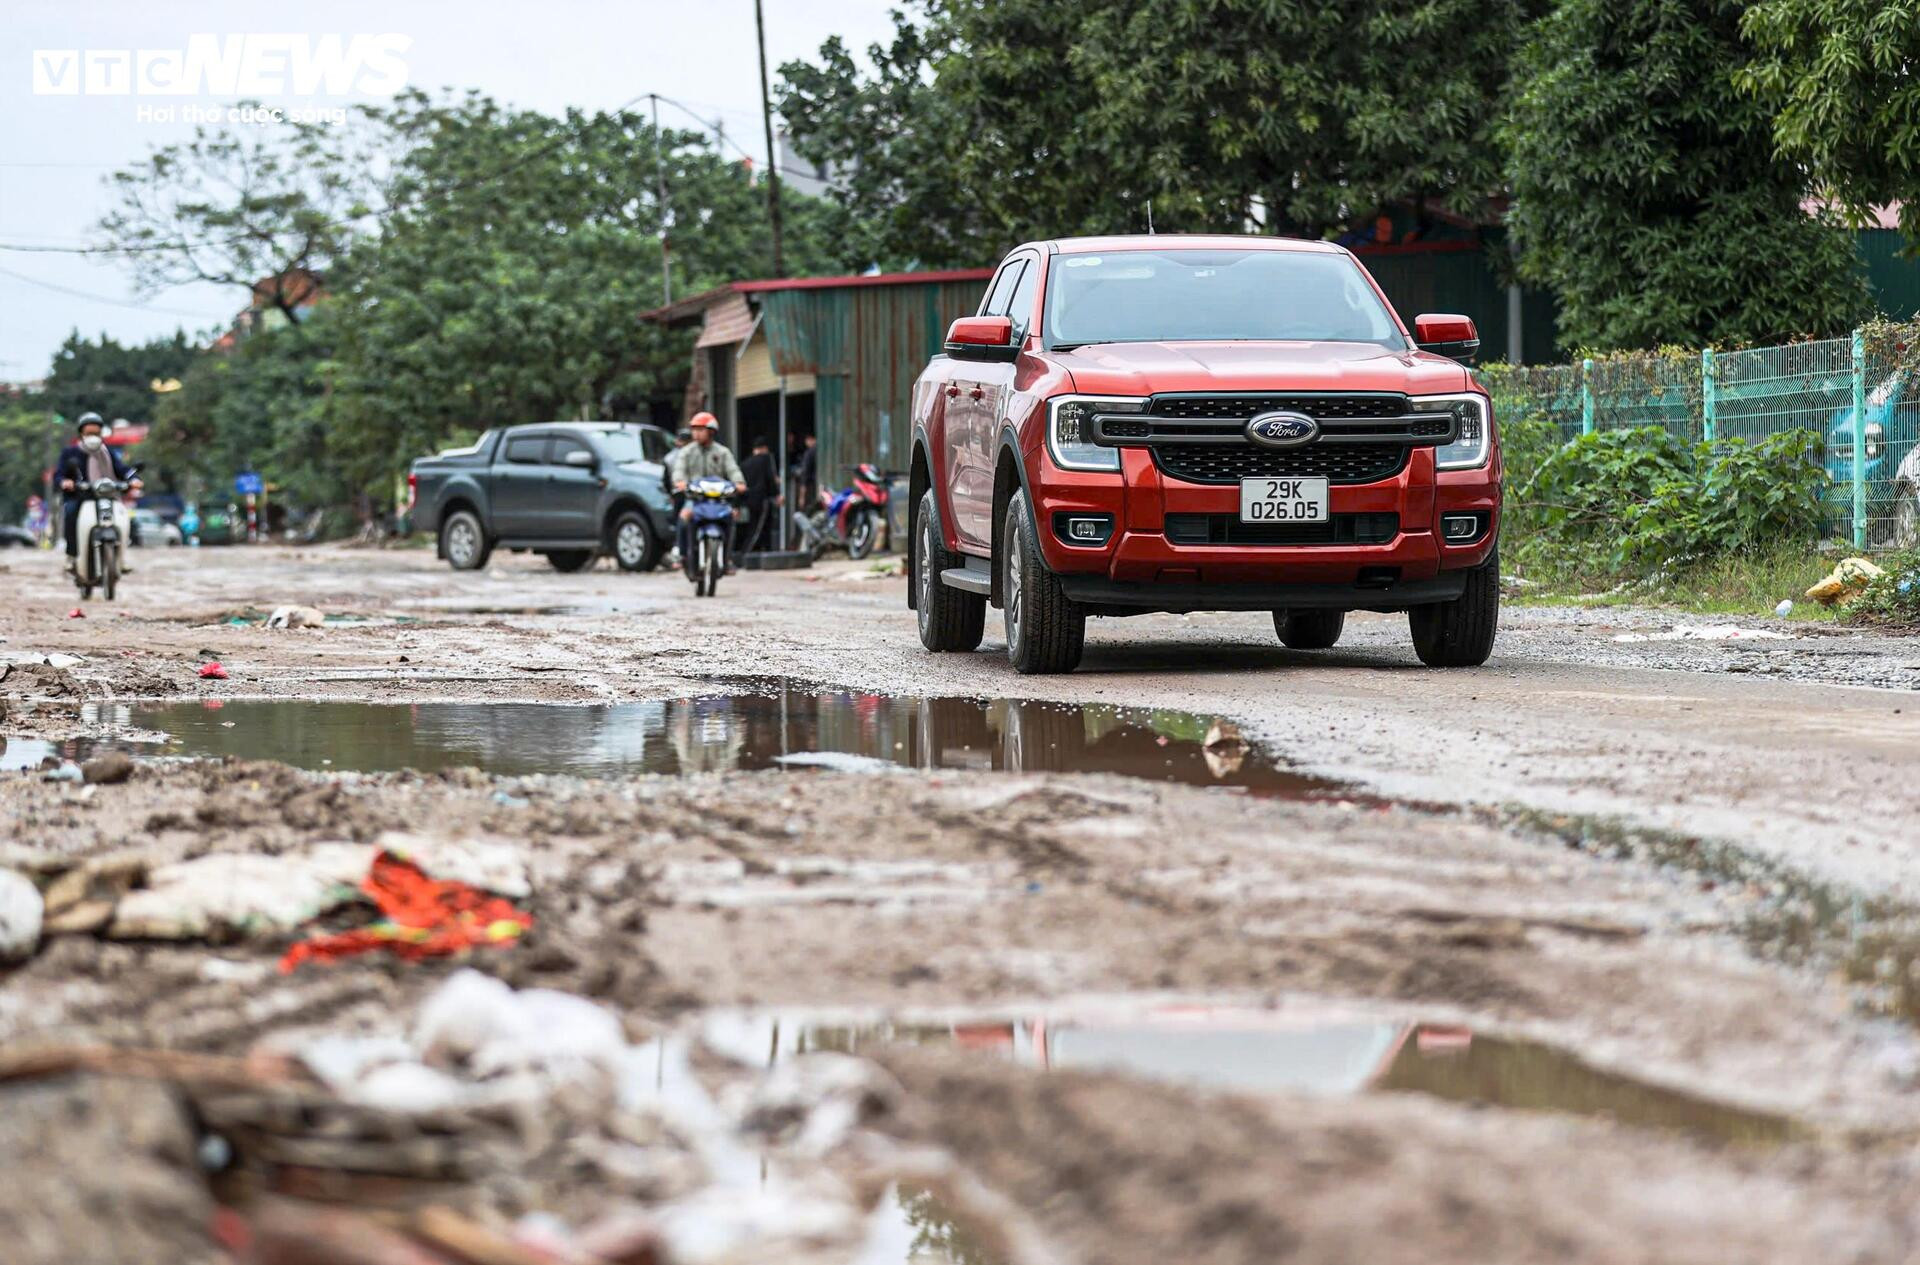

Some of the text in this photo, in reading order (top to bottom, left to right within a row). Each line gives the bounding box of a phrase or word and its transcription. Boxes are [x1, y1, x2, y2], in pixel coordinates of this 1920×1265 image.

[1266, 421, 1300, 436] Ford
[1266, 481, 1302, 499] 29K
[1251, 501, 1318, 519] 026.05
